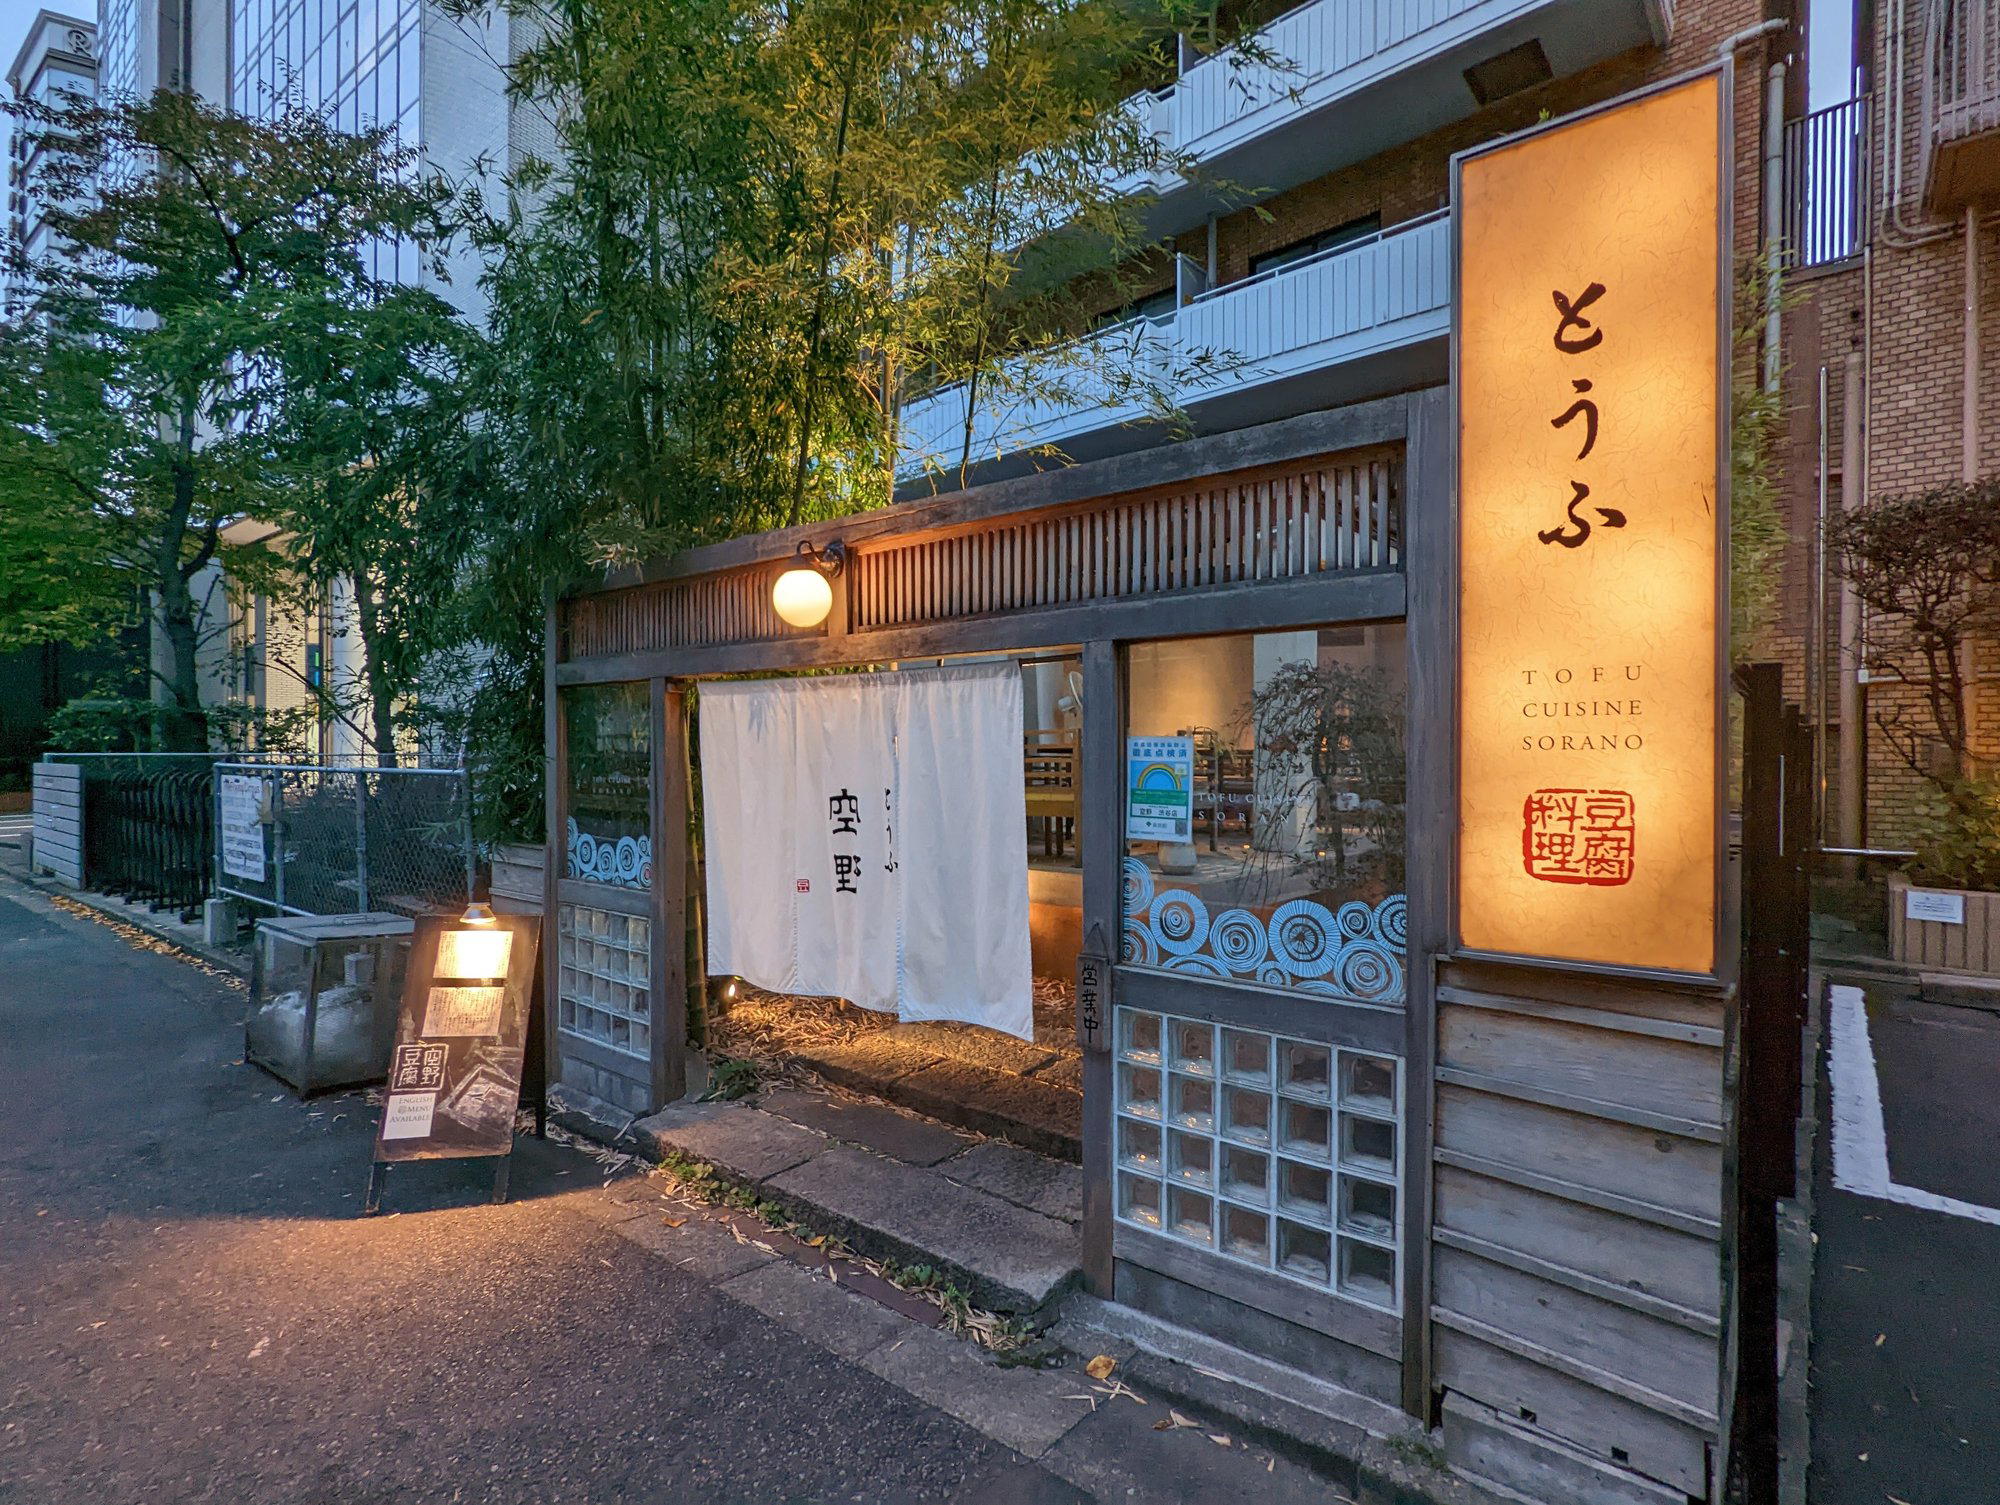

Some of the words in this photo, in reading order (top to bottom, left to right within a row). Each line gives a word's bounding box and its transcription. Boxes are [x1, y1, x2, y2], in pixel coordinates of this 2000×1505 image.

[1538, 282, 1627, 548] とうふ
[1522, 665, 1642, 684] TOFU
[1523, 700, 1643, 718] CUISINE
[1522, 734, 1644, 751] SORANO
[1198, 792, 1236, 803] TOFU
[1198, 811, 1312, 823] SORAN
[884, 788, 898, 873] とうふ
[829, 788, 861, 893] 空野
[1082, 964, 1099, 1043] 営業中
[420, 1047, 442, 1085] 空野
[399, 1096, 433, 1104] ENGLISH
[389, 1114, 430, 1123] AVAILABLE
